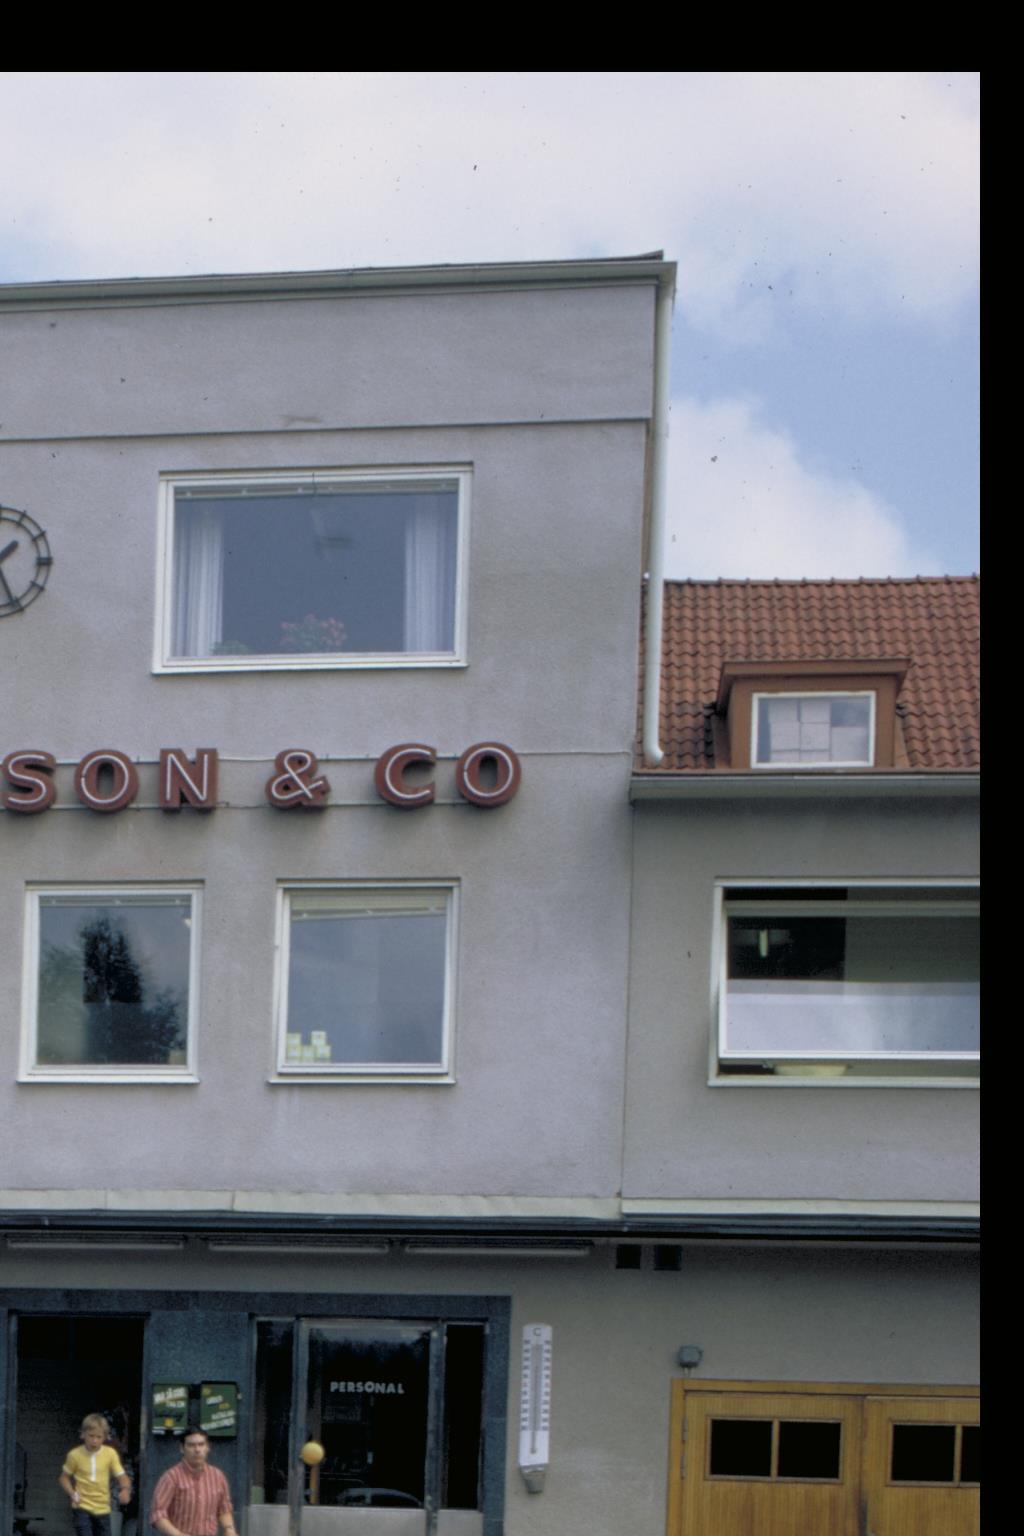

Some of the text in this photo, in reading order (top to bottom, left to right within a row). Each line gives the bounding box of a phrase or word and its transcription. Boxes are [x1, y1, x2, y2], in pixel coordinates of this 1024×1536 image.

[264, 748, 331, 809] &
[374, 741, 522, 807] CO
[329, 1380, 406, 1395] PERSONAL
